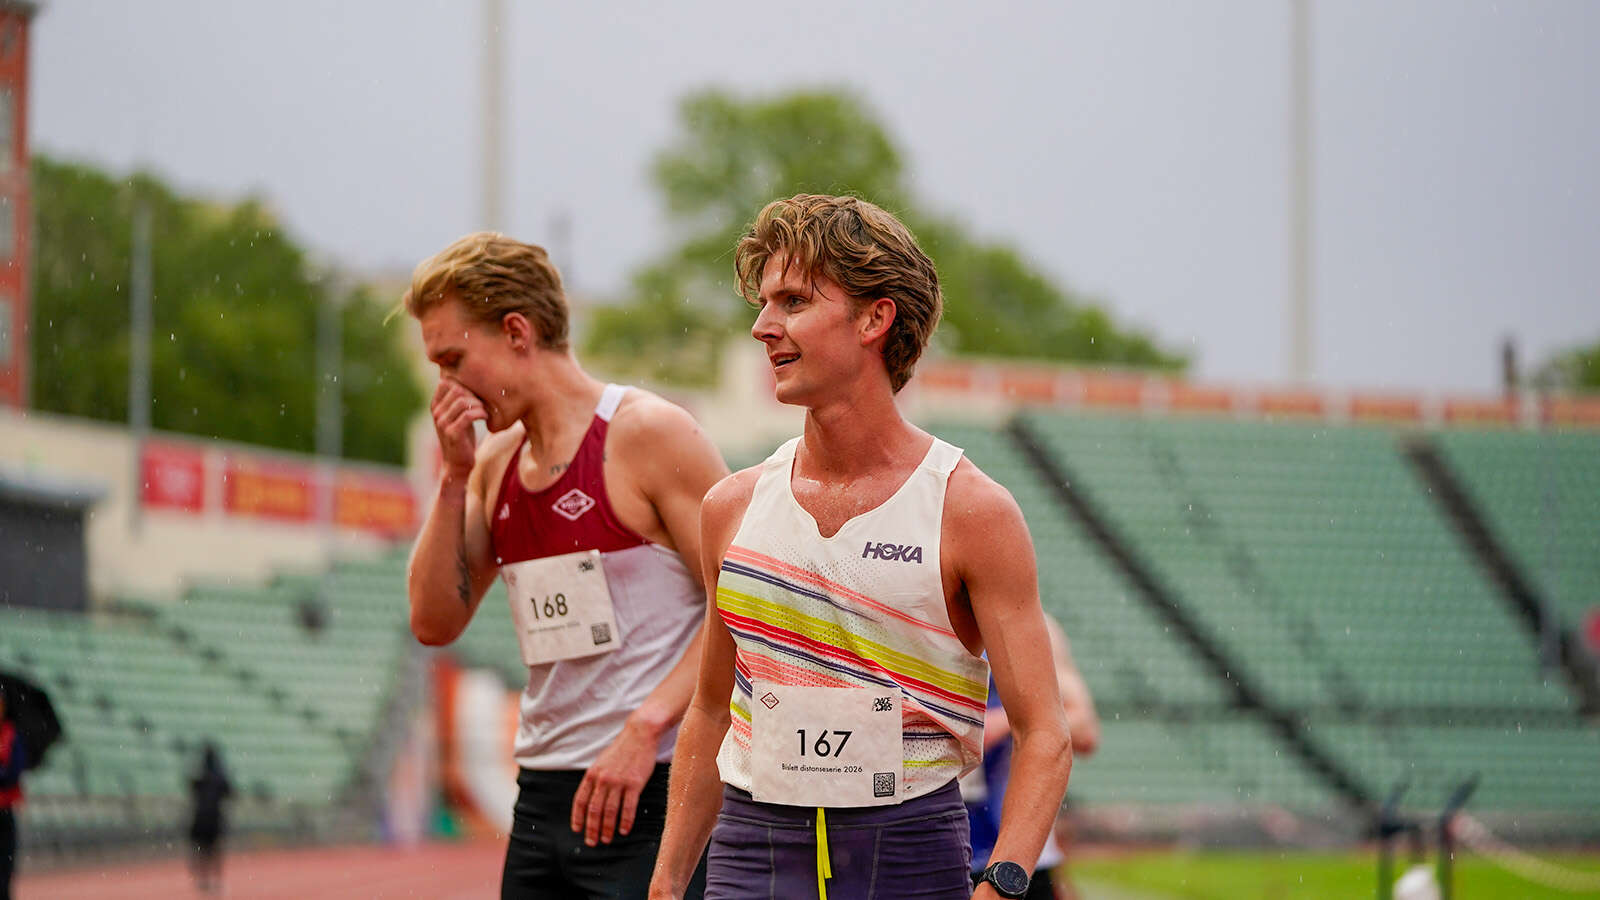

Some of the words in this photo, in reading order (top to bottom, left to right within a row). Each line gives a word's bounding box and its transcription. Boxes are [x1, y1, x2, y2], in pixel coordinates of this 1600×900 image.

[862, 541, 922, 564] HOKA
[530, 593, 568, 620] 168
[797, 729, 852, 758] 167
[782, 763, 798, 771] Bislett
[843, 765, 863, 773] 2026
